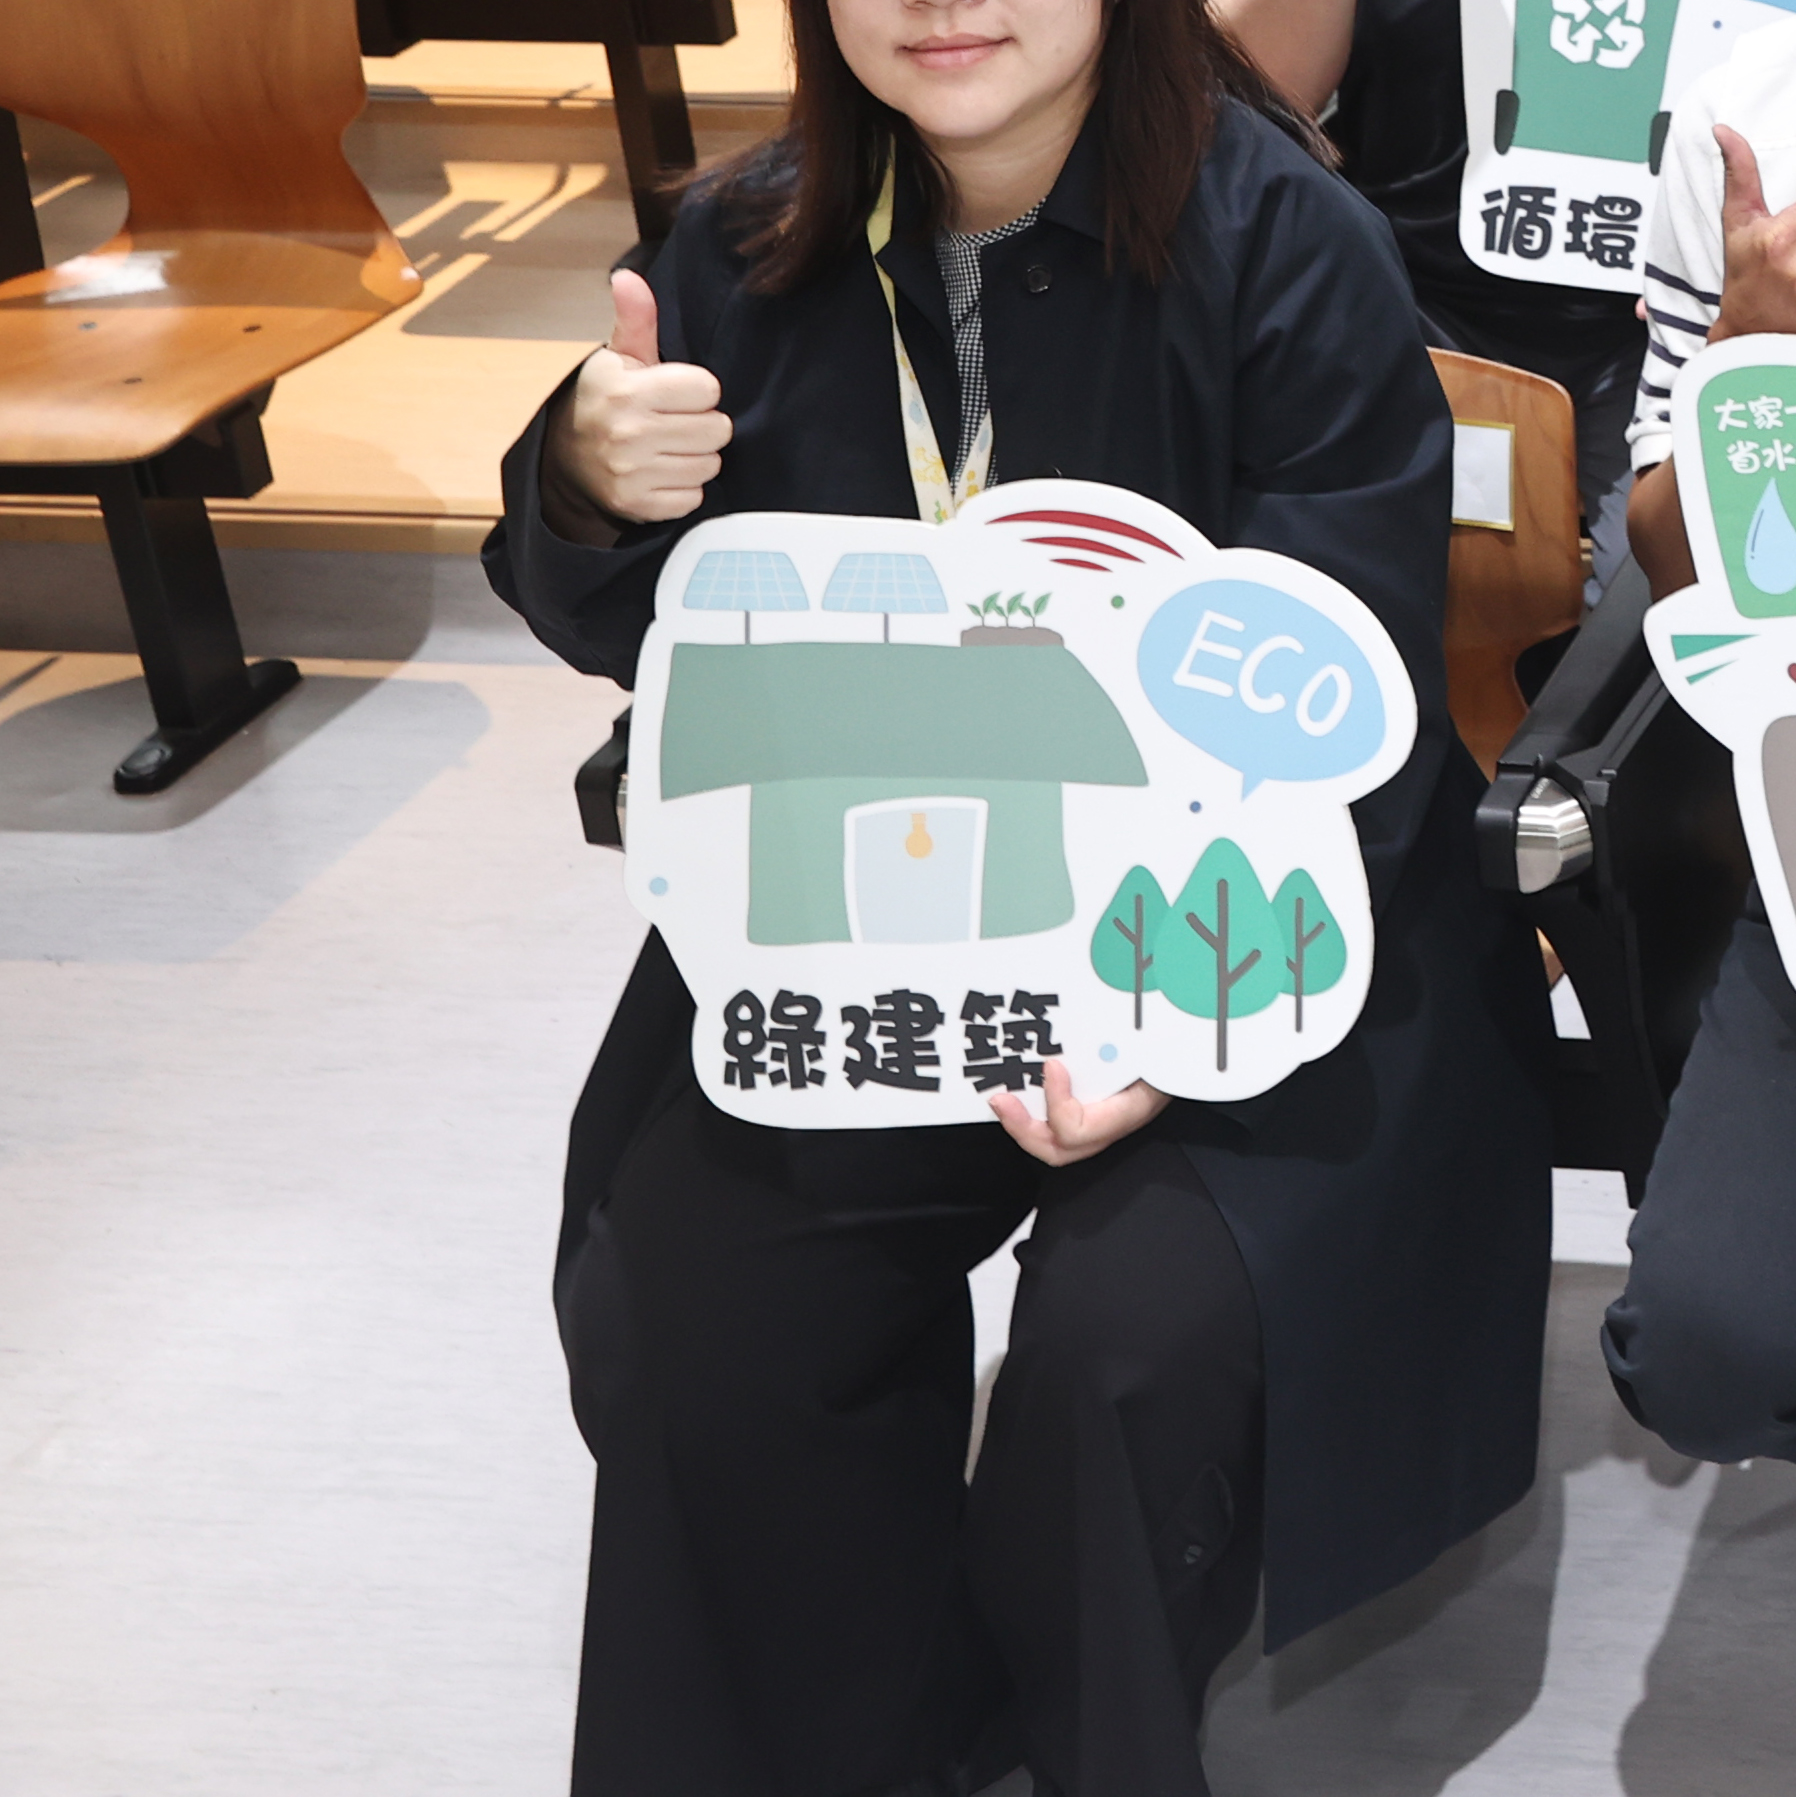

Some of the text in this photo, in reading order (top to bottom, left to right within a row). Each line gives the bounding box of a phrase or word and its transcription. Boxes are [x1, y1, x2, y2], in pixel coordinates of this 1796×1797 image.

[1480, 185, 1643, 271] 循環
[1172, 608, 1353, 737] ECO
[722, 989, 1063, 1093] 綠建築
